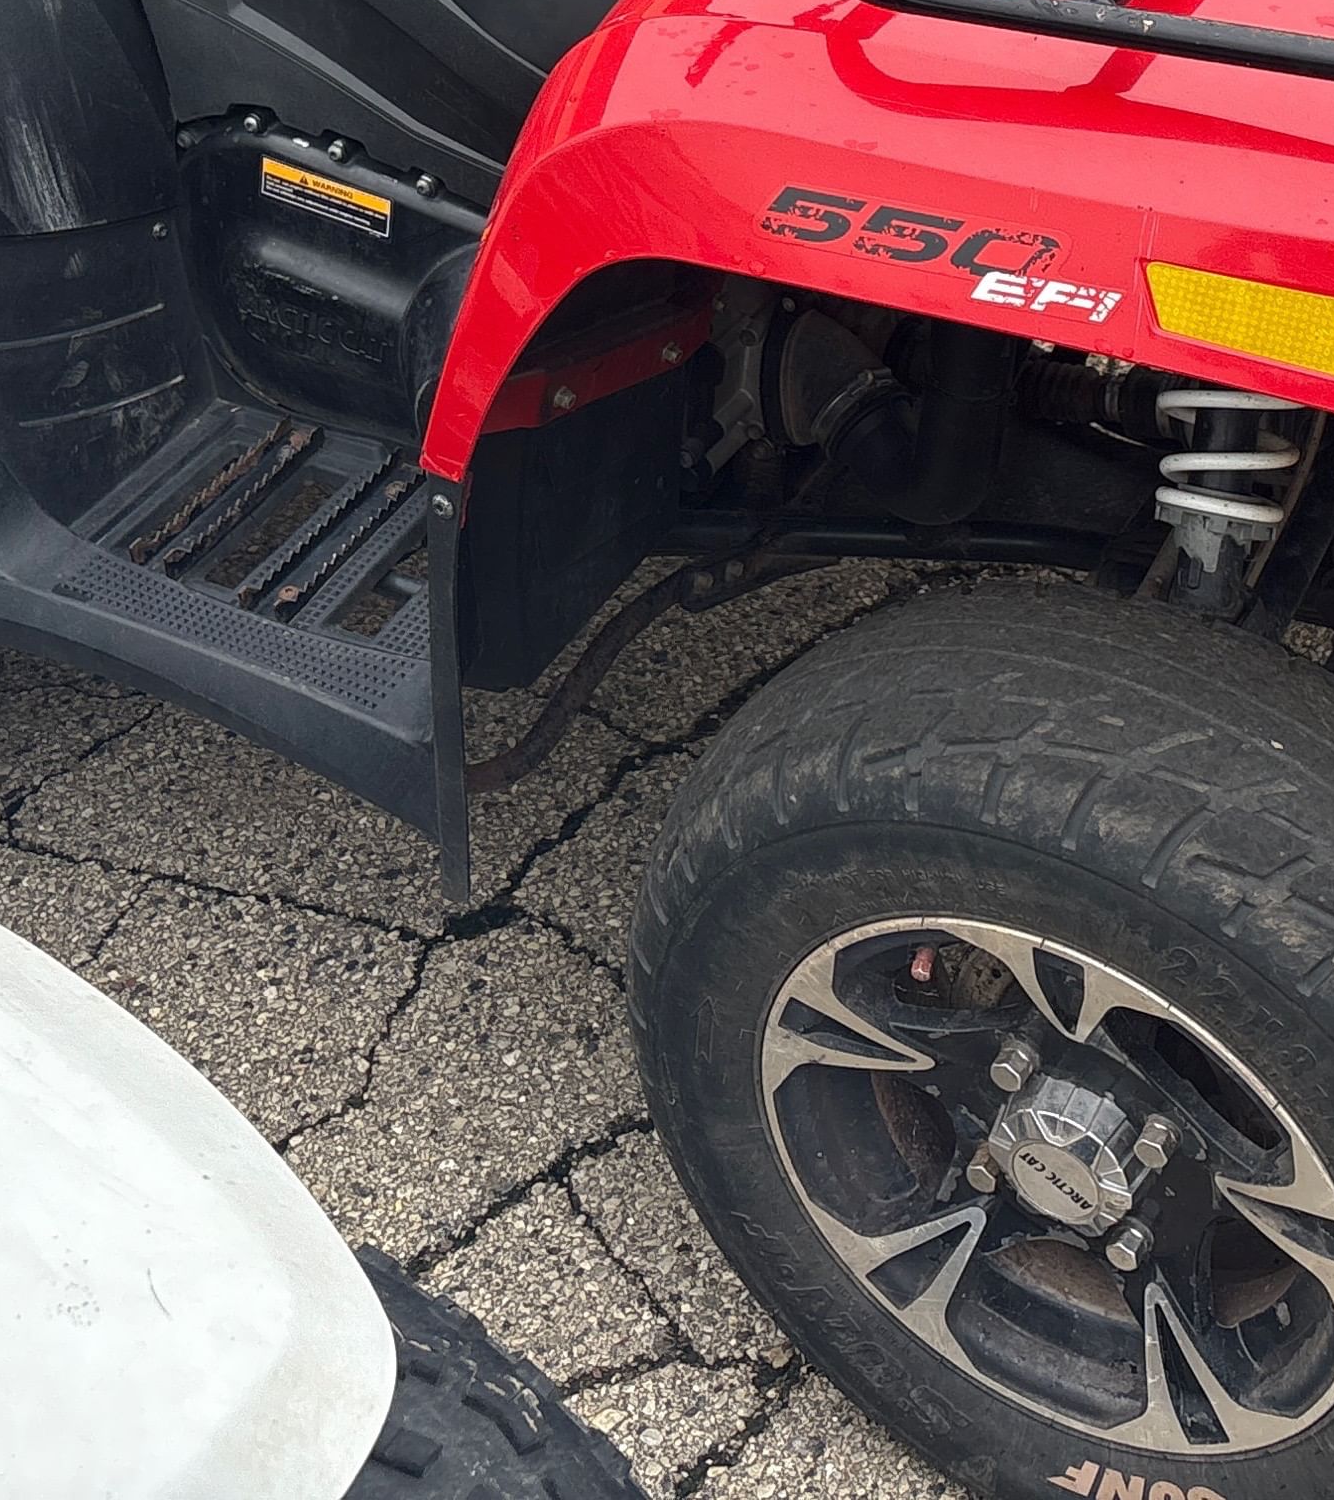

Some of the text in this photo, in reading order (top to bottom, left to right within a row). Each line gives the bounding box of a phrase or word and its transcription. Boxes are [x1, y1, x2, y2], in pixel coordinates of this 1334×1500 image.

[312, 179, 355, 200] WARNING
[760, 185, 1061, 278] 550
[970, 271, 1123, 324] EFI
[1018, 1151, 1094, 1211] ARCTIC CAT
